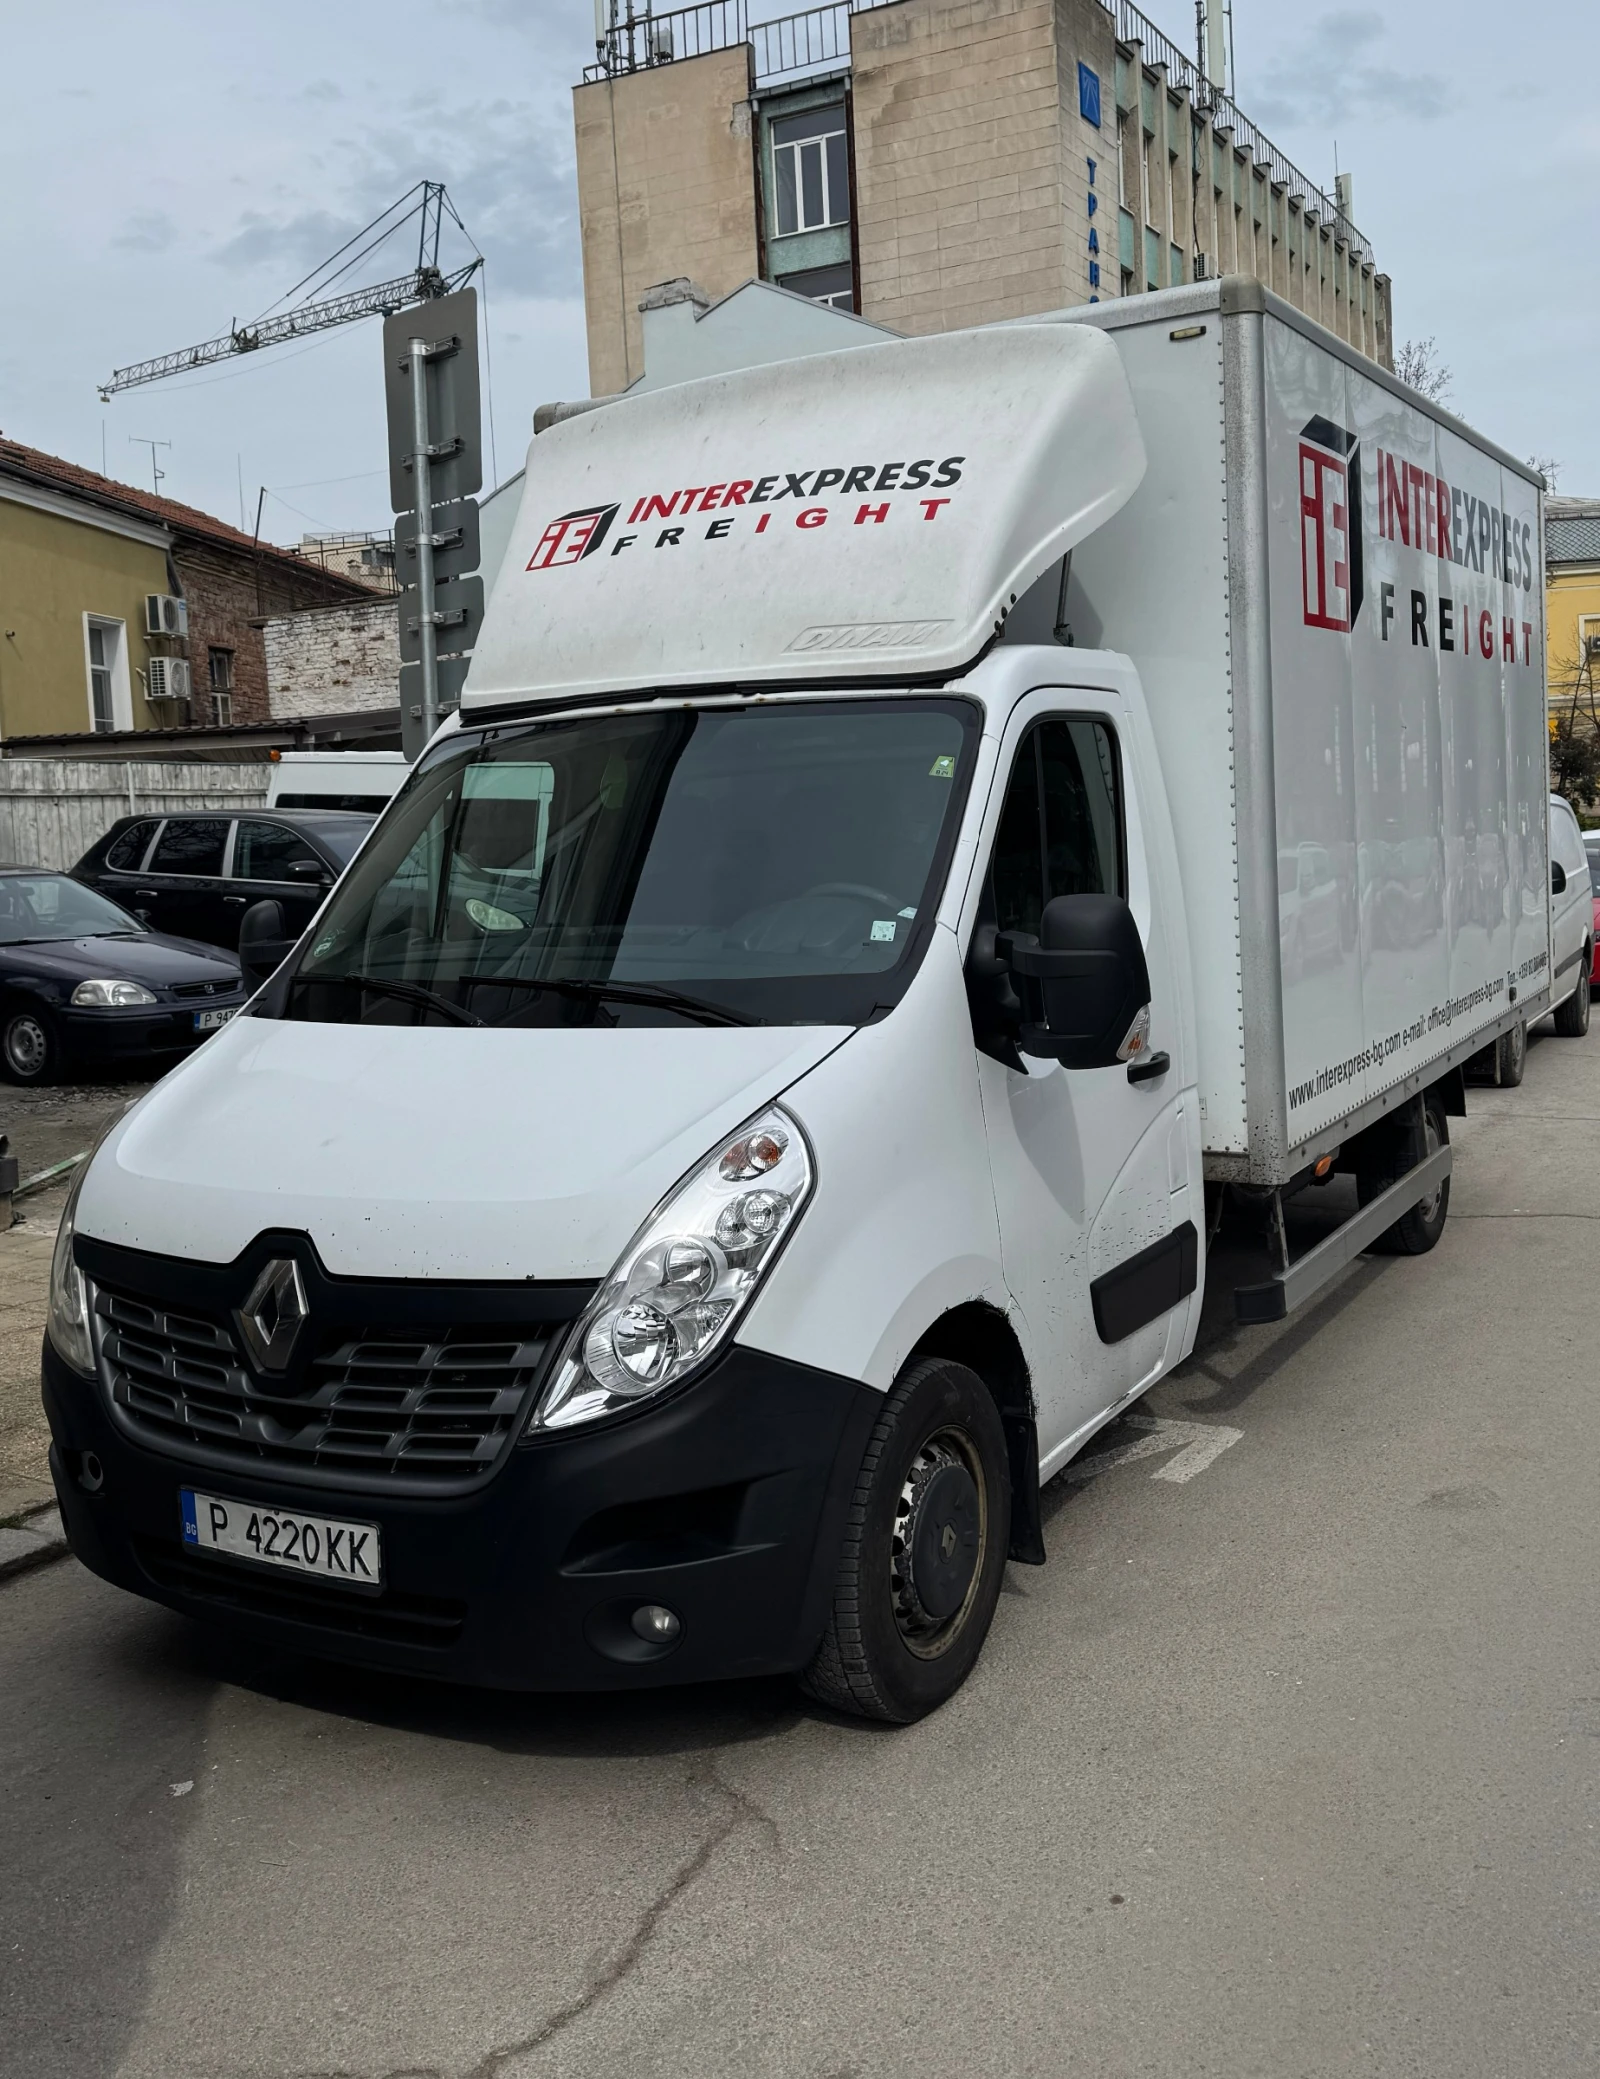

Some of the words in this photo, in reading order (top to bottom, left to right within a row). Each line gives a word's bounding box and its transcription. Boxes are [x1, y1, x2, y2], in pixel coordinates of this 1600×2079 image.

[626, 457, 966, 525] INTEREXPRESS
[1377, 447, 1532, 592] INTEREXPRESS
[611, 499, 951, 556] FREIGHT
[1380, 581, 1532, 666] FREIGHT
[205, 1014, 211, 1026] P
[217, 1010, 238, 1025] 947
[1288, 1032, 1401, 1110] www.interexpress-bg.com
[1403, 1014, 1427, 1046] e-mail:
[1428, 978, 1504, 1031] office@interexpress-bg.com
[186, 1522, 197, 1536] BG
[209, 1502, 228, 1542] P
